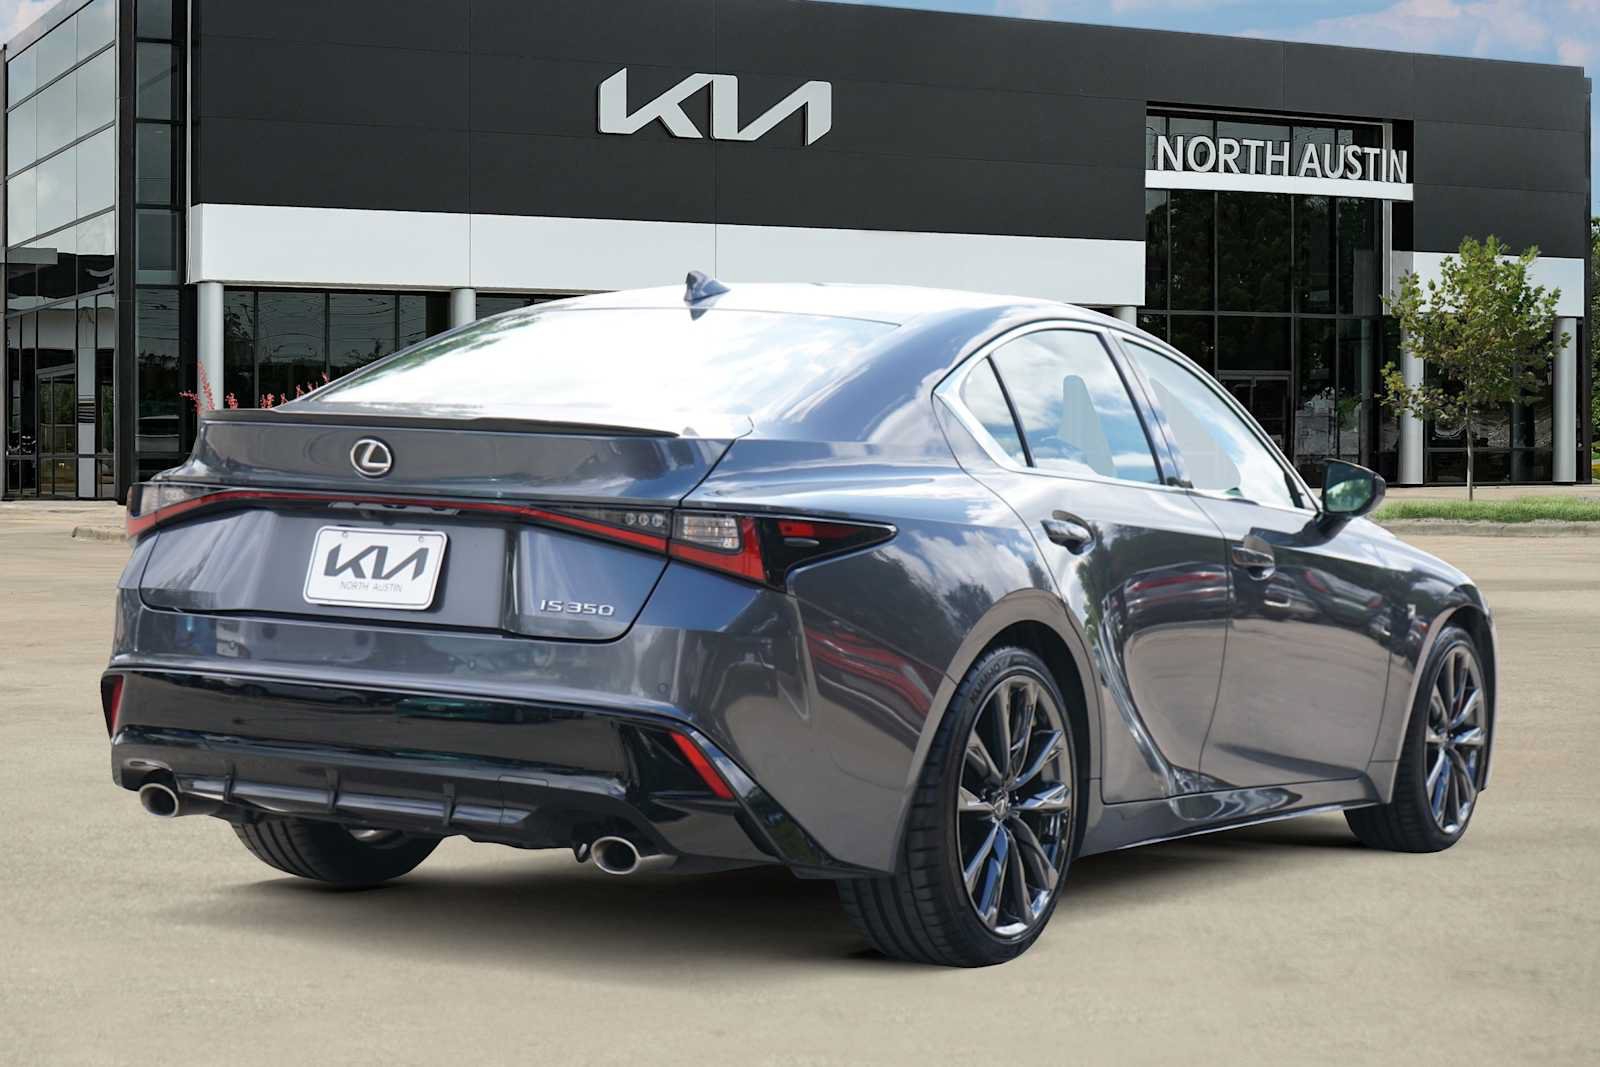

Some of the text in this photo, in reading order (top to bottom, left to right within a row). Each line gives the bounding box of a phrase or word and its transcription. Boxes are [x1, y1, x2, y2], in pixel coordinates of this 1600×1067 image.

[598, 67, 832, 146] KIA
[1157, 134, 1408, 184] NORTH AUSTIN
[323, 543, 429, 581] KIA
[341, 580, 403, 593] NORTH AUSTIN
